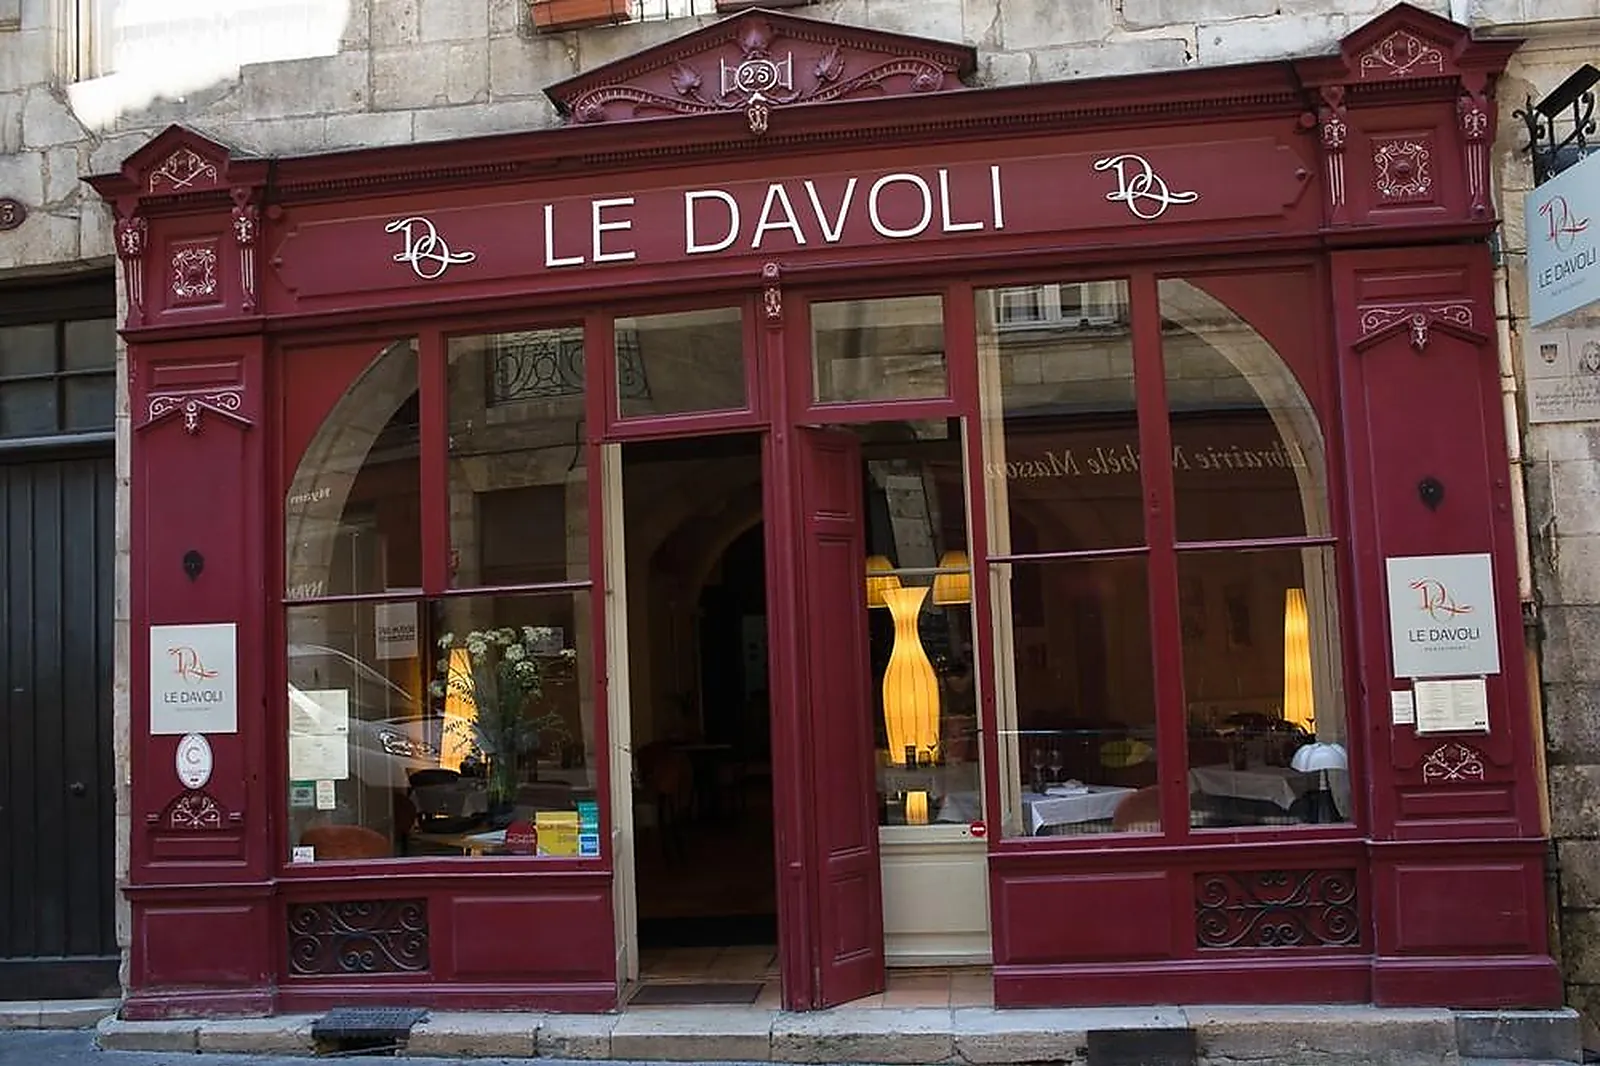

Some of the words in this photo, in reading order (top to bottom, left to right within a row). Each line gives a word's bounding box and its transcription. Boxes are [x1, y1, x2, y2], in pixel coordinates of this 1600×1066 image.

[742, 66, 769, 85] 25
[543, 197, 637, 268] LE
[684, 164, 1006, 255] DAVOLI
[1538, 267, 1552, 289] LE
[1555, 246, 1597, 280] DAVOLI
[1408, 629, 1426, 643] LE
[1429, 627, 1480, 642] DAVOLI
[164, 691, 178, 704] LE
[180, 690, 223, 703] DAVOLI
